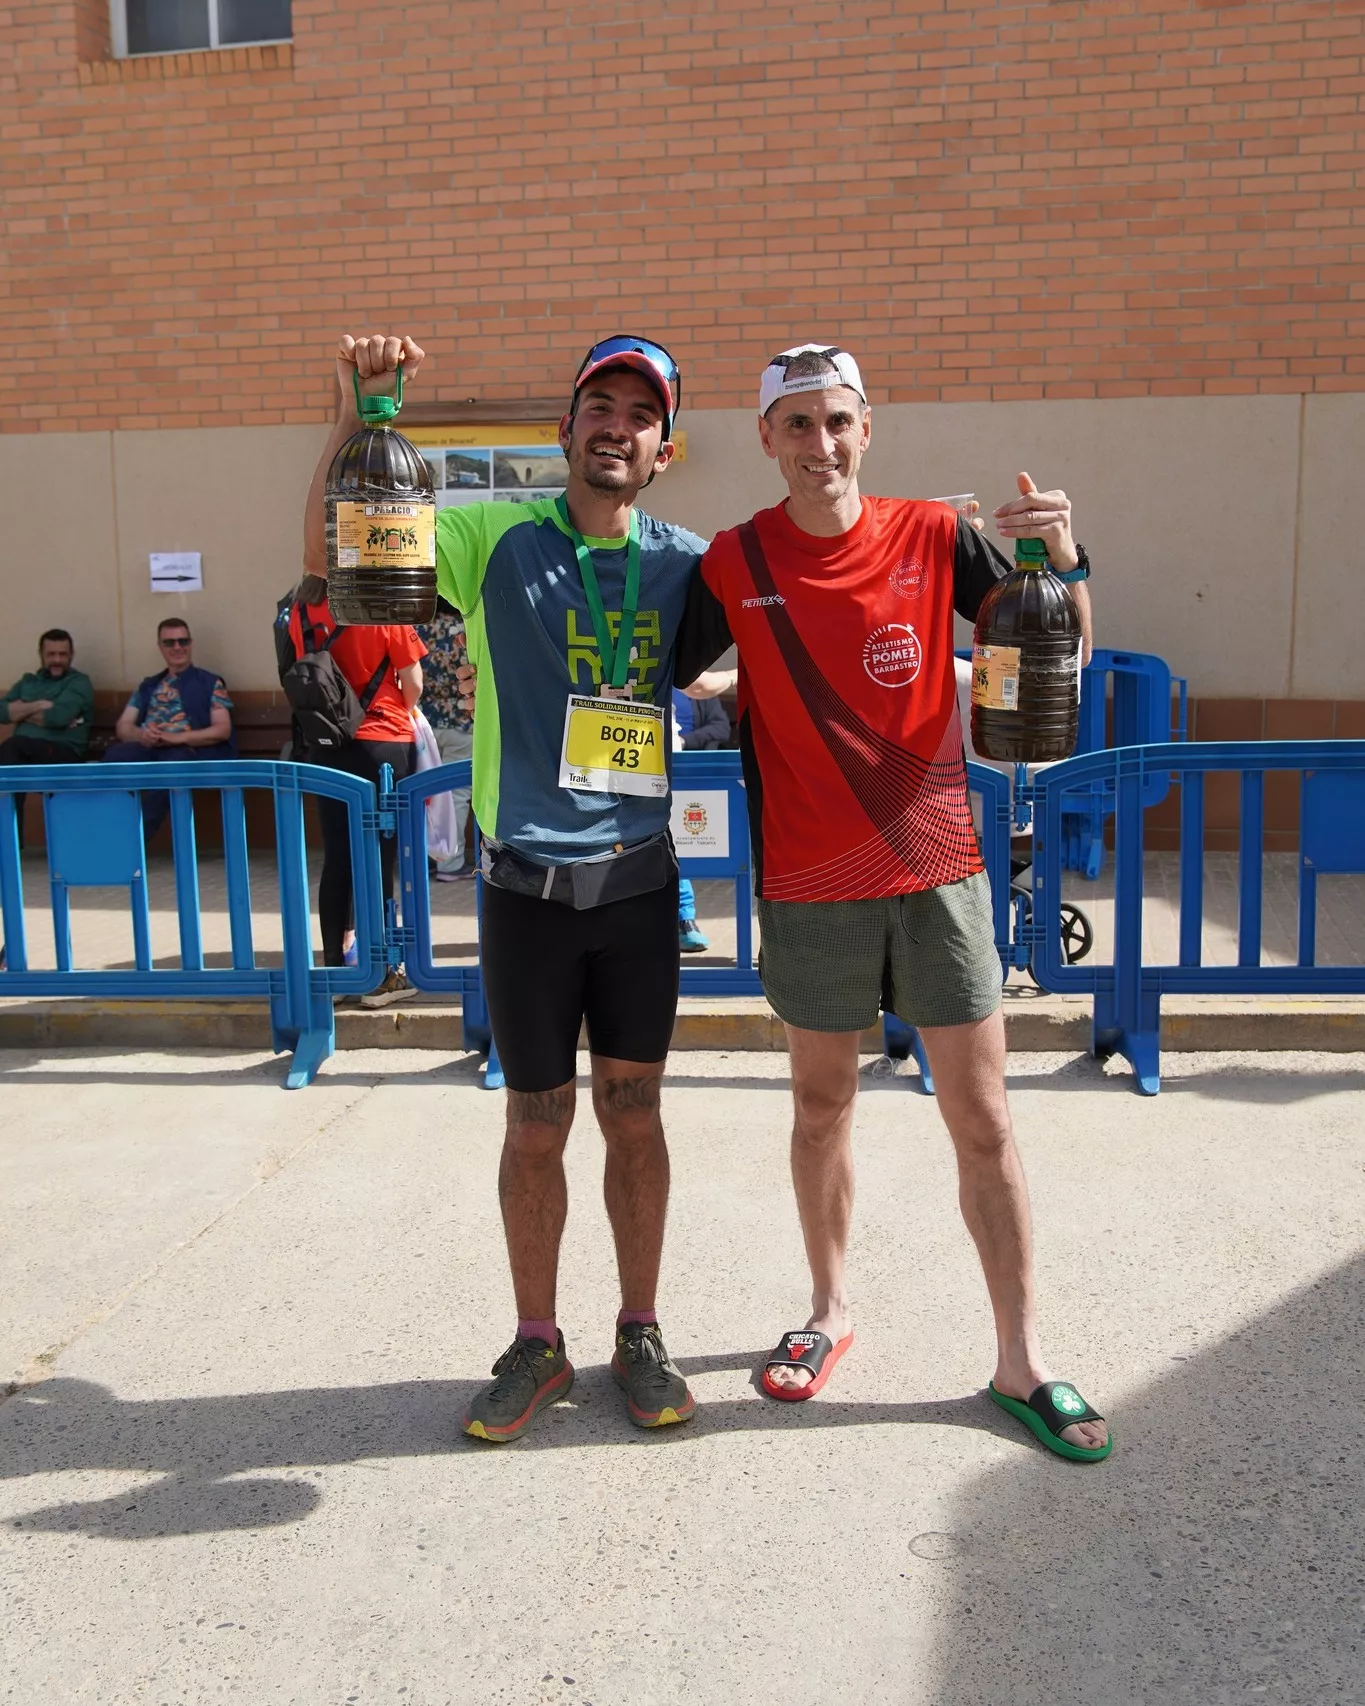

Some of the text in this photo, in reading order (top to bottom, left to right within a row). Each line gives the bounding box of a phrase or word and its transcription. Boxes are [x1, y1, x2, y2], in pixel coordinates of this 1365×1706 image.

[373, 505, 411, 514] PALACIO
[898, 564, 917, 575] GENTE
[871, 637, 914, 651] ATLETISMO
[872, 647, 917, 664] PÓMEZ
[874, 660, 918, 674] BARBASTRO
[573, 699, 594, 708] TRAIL
[594, 702, 629, 712] SOLIDARIA
[600, 725, 655, 746] BORJA
[612, 747, 640, 769] 43
[569, 772, 587, 784] Trail
